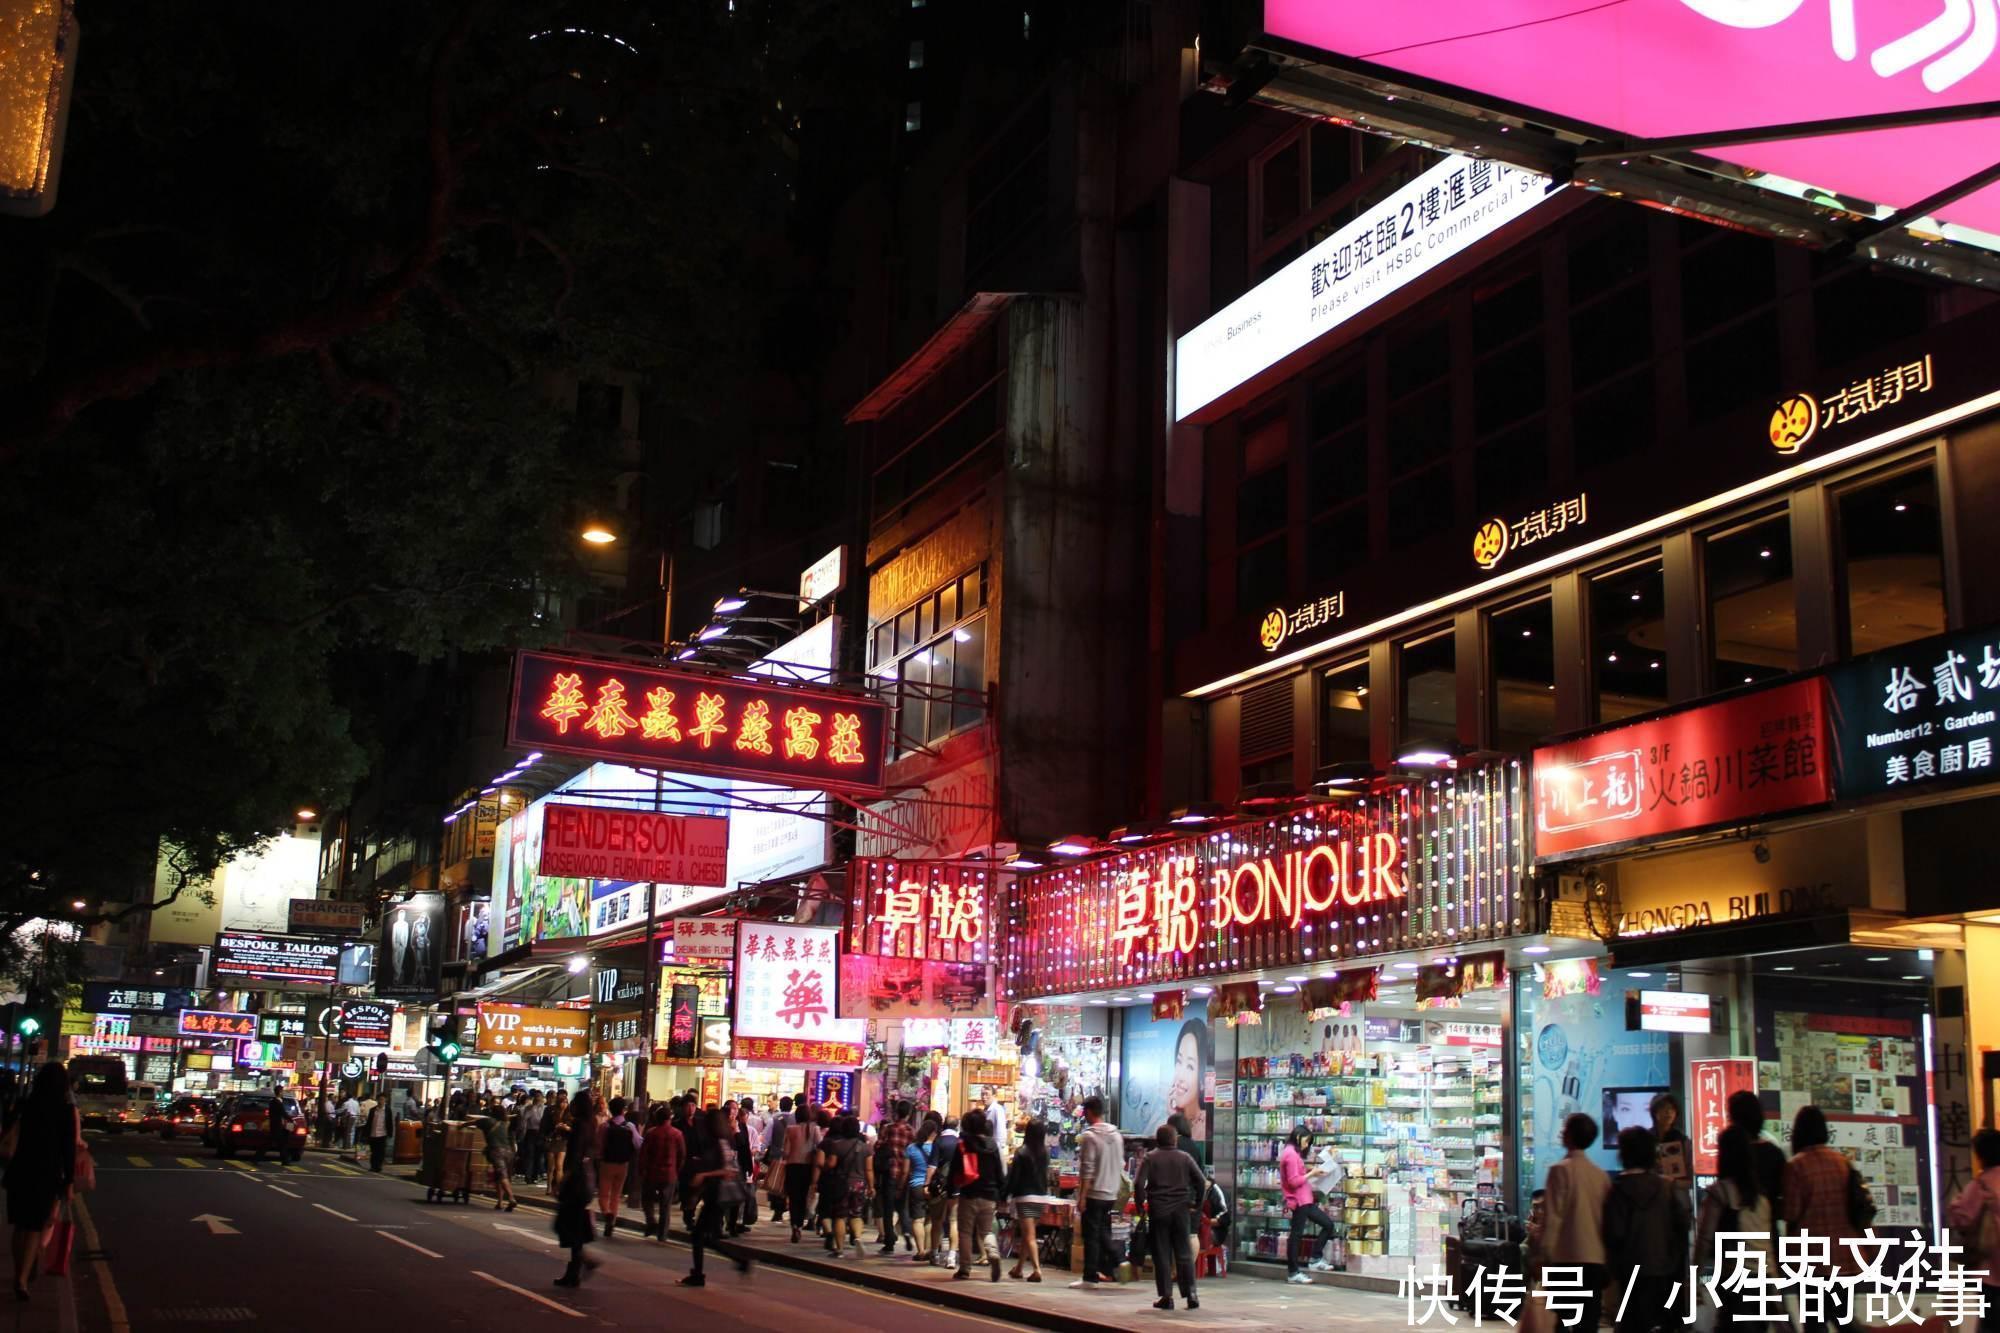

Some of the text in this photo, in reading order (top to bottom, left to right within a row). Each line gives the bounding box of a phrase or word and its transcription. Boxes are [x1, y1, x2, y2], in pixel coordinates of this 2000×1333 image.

[1311, 174, 1547, 322] Please visit HSBC Commercial Se
[1227, 312, 1262, 341] Business
[541, 672, 866, 764] 華泰蟲草燕窩莊
[1866, 710, 1996, 748] Number12 Garden
[1650, 742, 1671, 766] 3/F
[1885, 737, 1993, 785] 美食廚房
[1649, 735, 1818, 812] 火鍋川菜館
[1551, 764, 1633, 817] 川上龍
[546, 808, 686, 855] HENDERSON
[543, 851, 608, 873] ROSEWOOD
[613, 857, 671, 878] FURNITURE
[677, 862, 684, 878] &
[690, 863, 725, 882] CHEST
[1213, 832, 1409, 930] BONJOUR
[294, 902, 359, 914] CHANGE
[1614, 882, 1836, 936] ZHONGDA BUILDING
[677, 922, 736, 938] 祥興花
[220, 938, 339, 955] BESPOKE TAILORS
[714, 945, 734, 955] FLOWE
[744, 933, 832, 963] 華泰蟲草燕
[108, 990, 166, 1005] 六福珠寶
[598, 968, 618, 1004] VIP
[776, 968, 829, 1030] 藥
[345, 1005, 391, 1022] BESPOKE
[483, 1012, 521, 1031] VIP
[522, 1024, 544, 1034] watch
[545, 1024, 552, 1034] &
[553, 1025, 587, 1038] jewellery
[672, 1001, 693, 1044] 人民幣
[603, 1020, 638, 1040] 名人鐘錶珠
[961, 1020, 985, 1052] 藥
